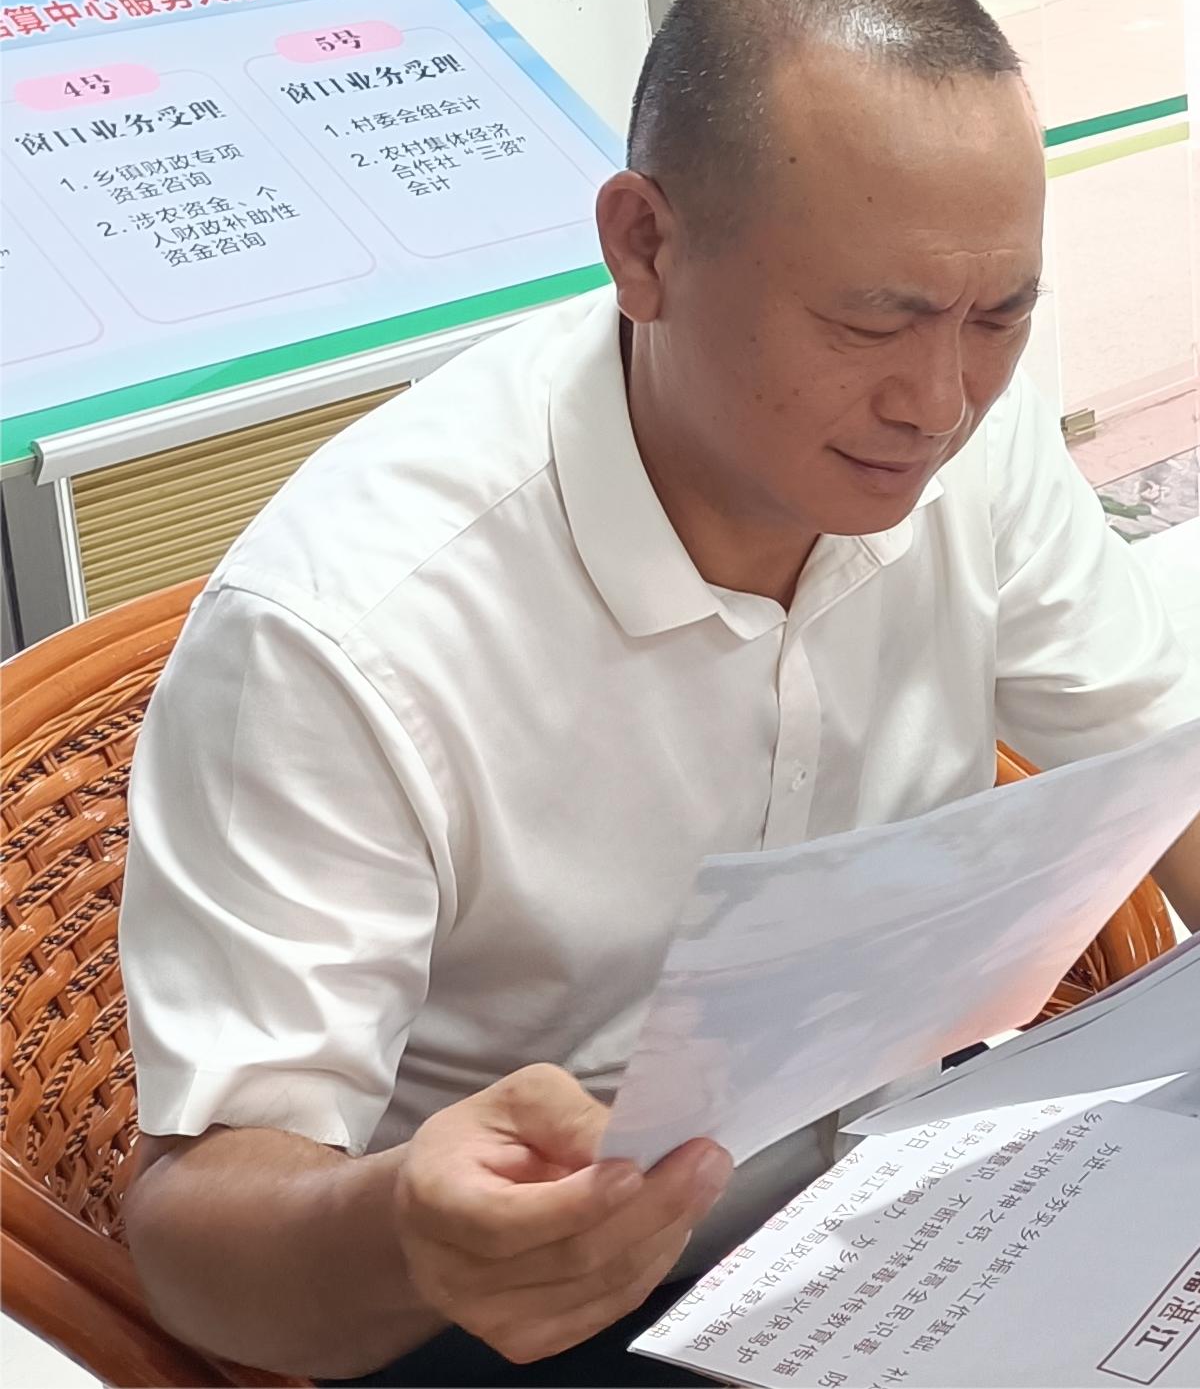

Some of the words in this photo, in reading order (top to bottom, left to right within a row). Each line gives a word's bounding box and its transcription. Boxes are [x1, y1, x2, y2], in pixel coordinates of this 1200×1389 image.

[314, 29, 362, 54] 5号
[62, 72, 113, 101] 4号
[280, 53, 466, 107] 窗口业务受理
[14, 98, 229, 159] 窗口业务受理
[108, 170, 213, 206] 资金咨询
[407, 175, 452, 197] 会计
[151, 201, 301, 249] 人财政补助性
[163, 231, 267, 267] 资金咨询
